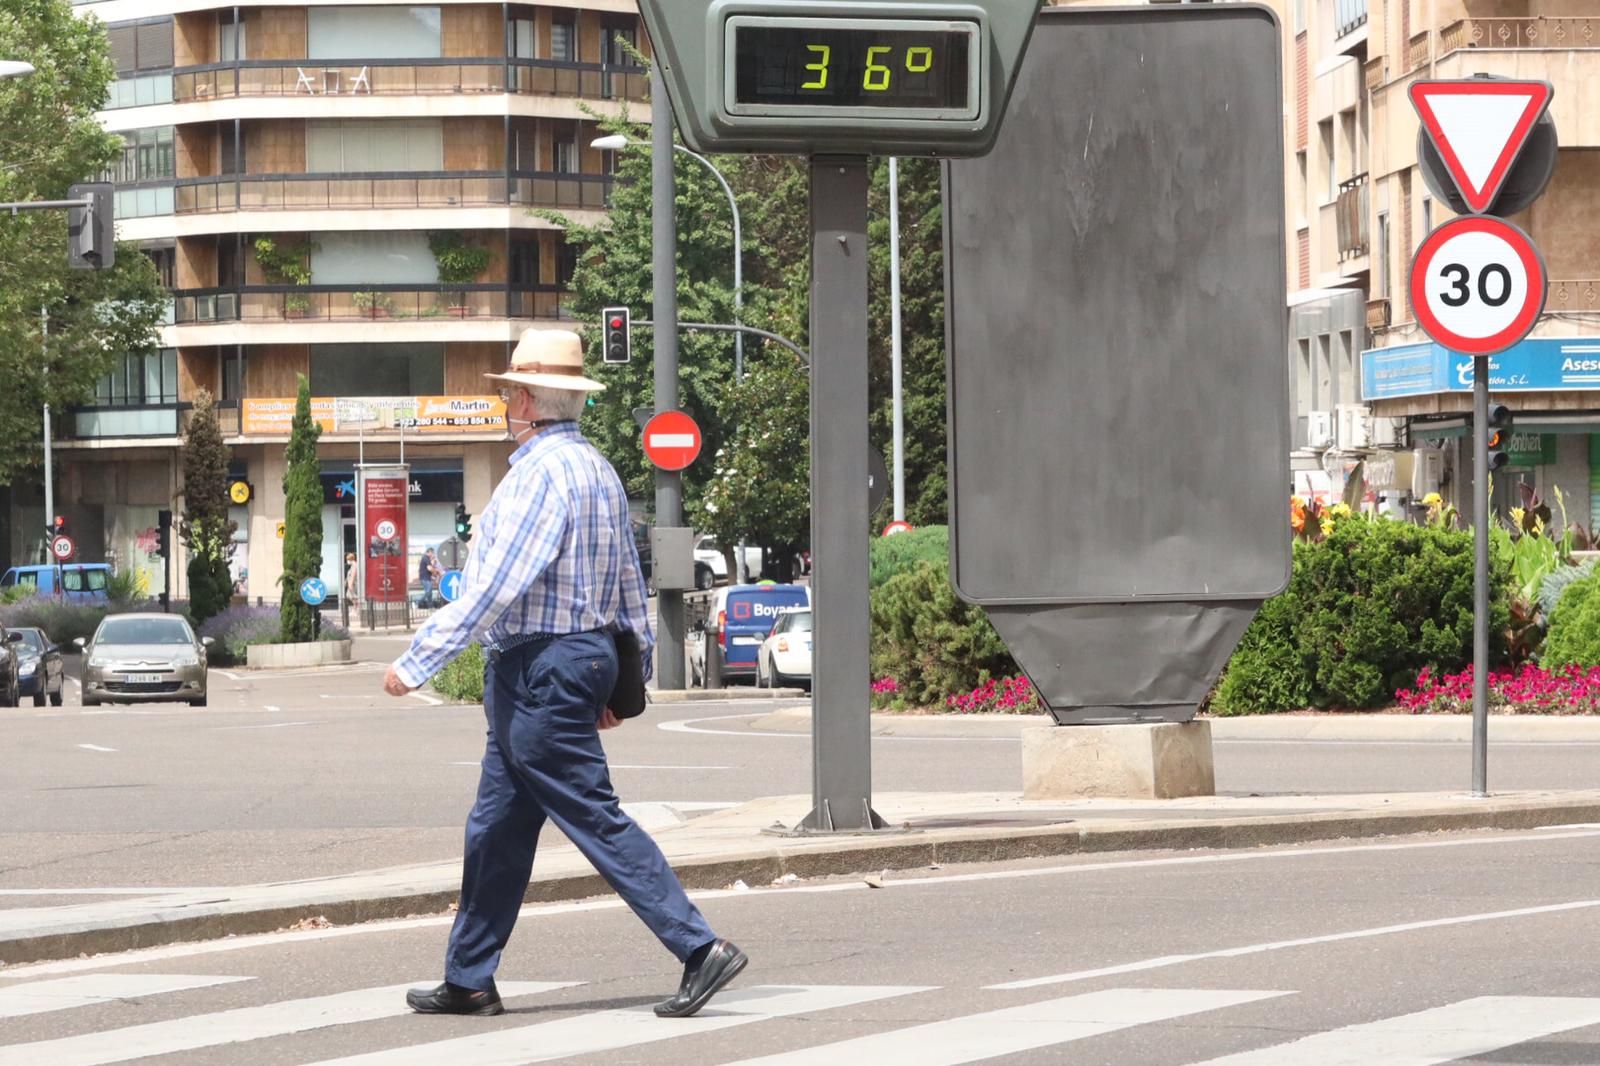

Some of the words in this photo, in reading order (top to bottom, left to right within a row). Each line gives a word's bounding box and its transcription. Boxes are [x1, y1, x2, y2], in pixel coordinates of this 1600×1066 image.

[1440, 262, 1512, 307] 30
[379, 526, 393, 535] 30
[56, 543, 69, 552] 30
